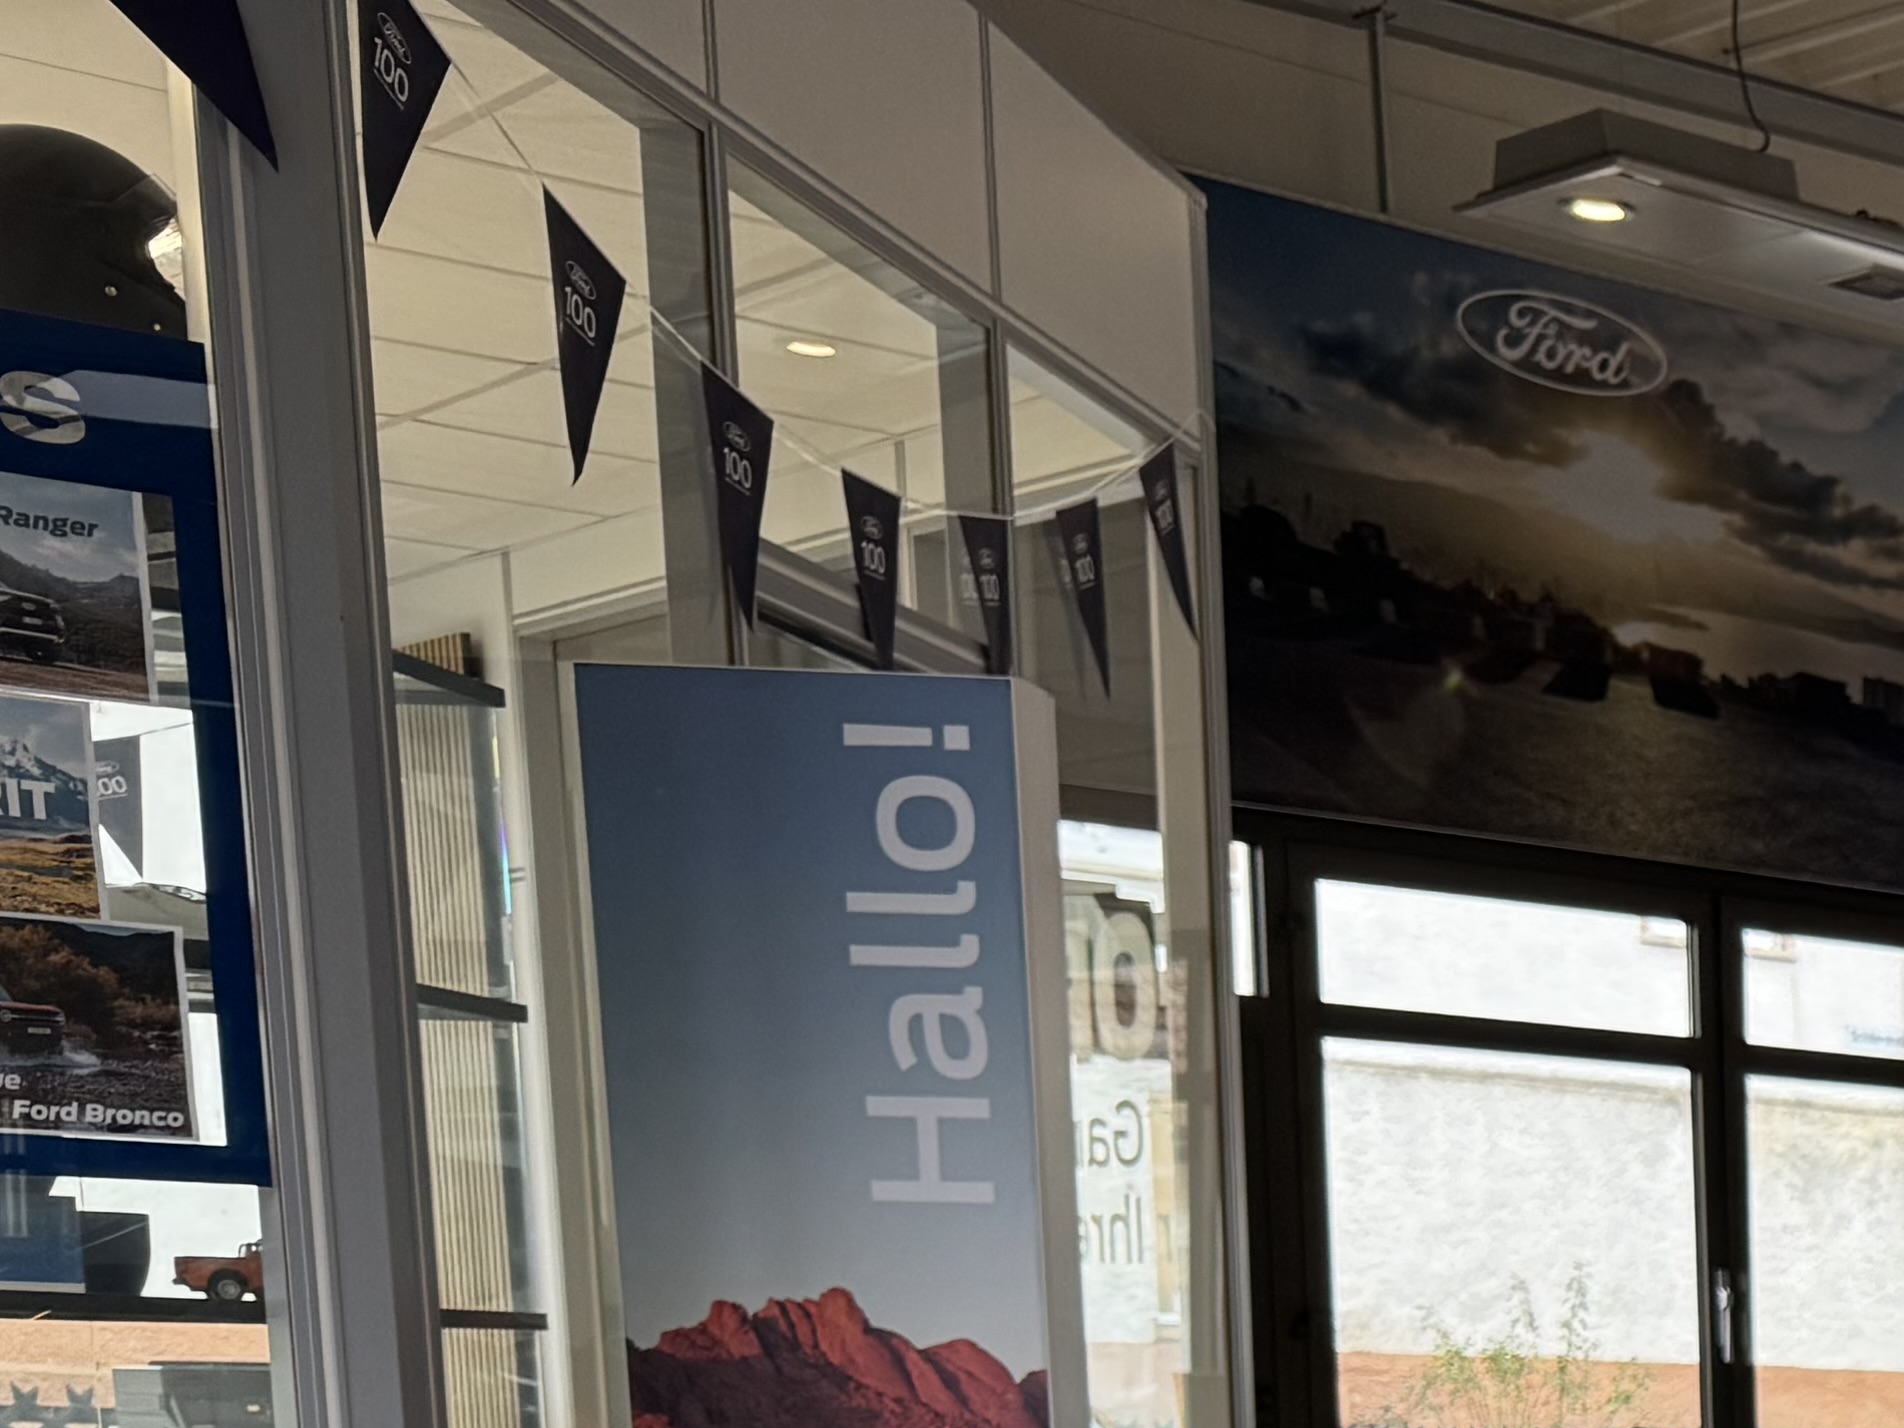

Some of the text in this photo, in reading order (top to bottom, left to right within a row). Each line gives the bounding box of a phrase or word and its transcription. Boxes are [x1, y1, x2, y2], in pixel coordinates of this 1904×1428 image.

[373, 37, 409, 102] 100
[564, 286, 597, 338] 100
[1497, 301, 1632, 385] Ford
[723, 447, 752, 489] 100
[0, 505, 98, 537] Ranger
[861, 540, 886, 574] 100
[0, 778, 56, 820] IT
[843, 723, 995, 1204] Hallo!
[12, 1099, 184, 1127] Ford Bronco
